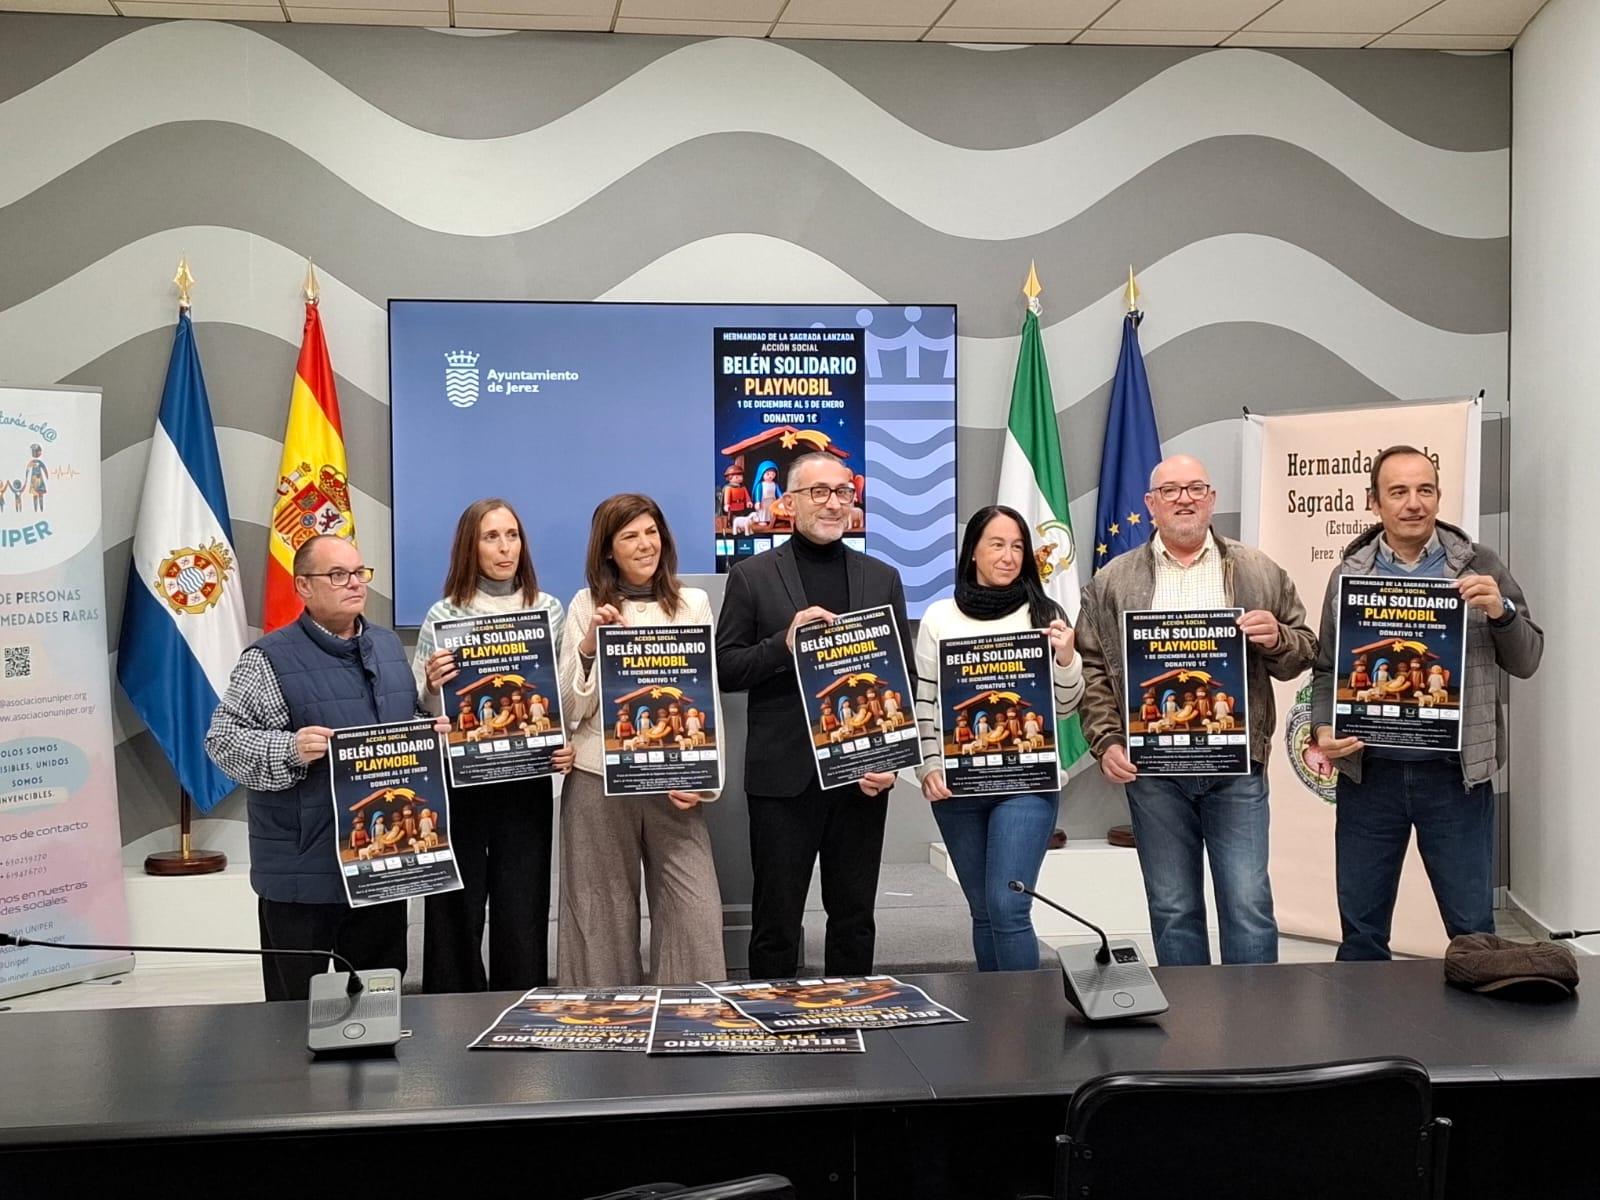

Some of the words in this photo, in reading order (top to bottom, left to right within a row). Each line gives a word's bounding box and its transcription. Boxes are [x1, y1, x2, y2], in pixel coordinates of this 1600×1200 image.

[790, 333, 821, 341] SAGRADA
[823, 333, 855, 341] LANZADA
[762, 343, 790, 352] ACCIÓN
[792, 344, 818, 352] SOCIAL
[723, 353, 770, 374] BELÉN
[774, 357, 857, 374] SOLIDARIO
[487, 369, 579, 382] Ayuntamiento
[487, 382, 503, 393] de
[506, 382, 539, 395] Jerez
[745, 378, 832, 396] PLAYMOBIL
[738, 401, 741, 409] 1
[743, 401, 752, 409] DE
[754, 401, 792, 409] DICIEMBRE
[794, 401, 803, 409] AL
[805, 401, 809, 409] 5
[811, 401, 820, 409] DE
[821, 401, 844, 409] ENERO
[763, 414, 804, 423] DONATIVO
[807, 414, 817, 423] 1€
[1288, 449, 1382, 476] Hermanda
[1288, 488, 1354, 517] Sagrada
[1311, 546, 1334, 562] Jerez
[16, 588, 81, 604] PERSONAS
[1348, 593, 1387, 607] BELÉN
[1390, 595, 1458, 609] SOLIDARIO
[62, 607, 99, 622] RARAS
[1365, 608, 1437, 621] PLAYMOBIL
[444, 632, 480, 648] BELÉN
[483, 628, 545, 645] SOLIDARIO
[801, 635, 833, 653] BELÉN
[835, 625, 890, 645] SOLIDARIO
[1133, 627, 1169, 640] BELÉN
[1173, 627, 1236, 640] SOLIDARIO
[462, 642, 529, 659] PLAYMOBIL
[606, 642, 642, 656] BELÉN
[644, 642, 706, 655] SOLIDARIO
[817, 640, 878, 662] PLAYMOBIL
[1150, 640, 1218, 652] PLAYMOBIL
[623, 656, 688, 668] PLAYMOBIL
[946, 651, 980, 665] BELÉN
[983, 647, 1043, 662] SOLIDARIO
[962, 661, 1026, 676] PLAYMOBIL
[26, 744, 58, 755] SOMOS
[339, 744, 374, 761] BELÉN
[376, 738, 434, 756] SOLIDARIO
[36, 757, 69, 769] UNIDOS
[356, 754, 419, 772] PLAYMOBIL
[12, 776, 43, 788] SOMOS
[20, 829, 35, 840] de
[36, 821, 89, 837] contacto
[21, 891, 36, 900] en
[37, 881, 88, 898] nuestras
[23, 896, 69, 912] sociales
[774, 1015, 877, 1026] SOLIDARIO
[492, 1035, 602, 1044] SOLIDARIO
[608, 1035, 648, 1044] LÉN
[664, 1039, 777, 1048] SOLIDARIO
[784, 1038, 846, 1046] BELÉN
